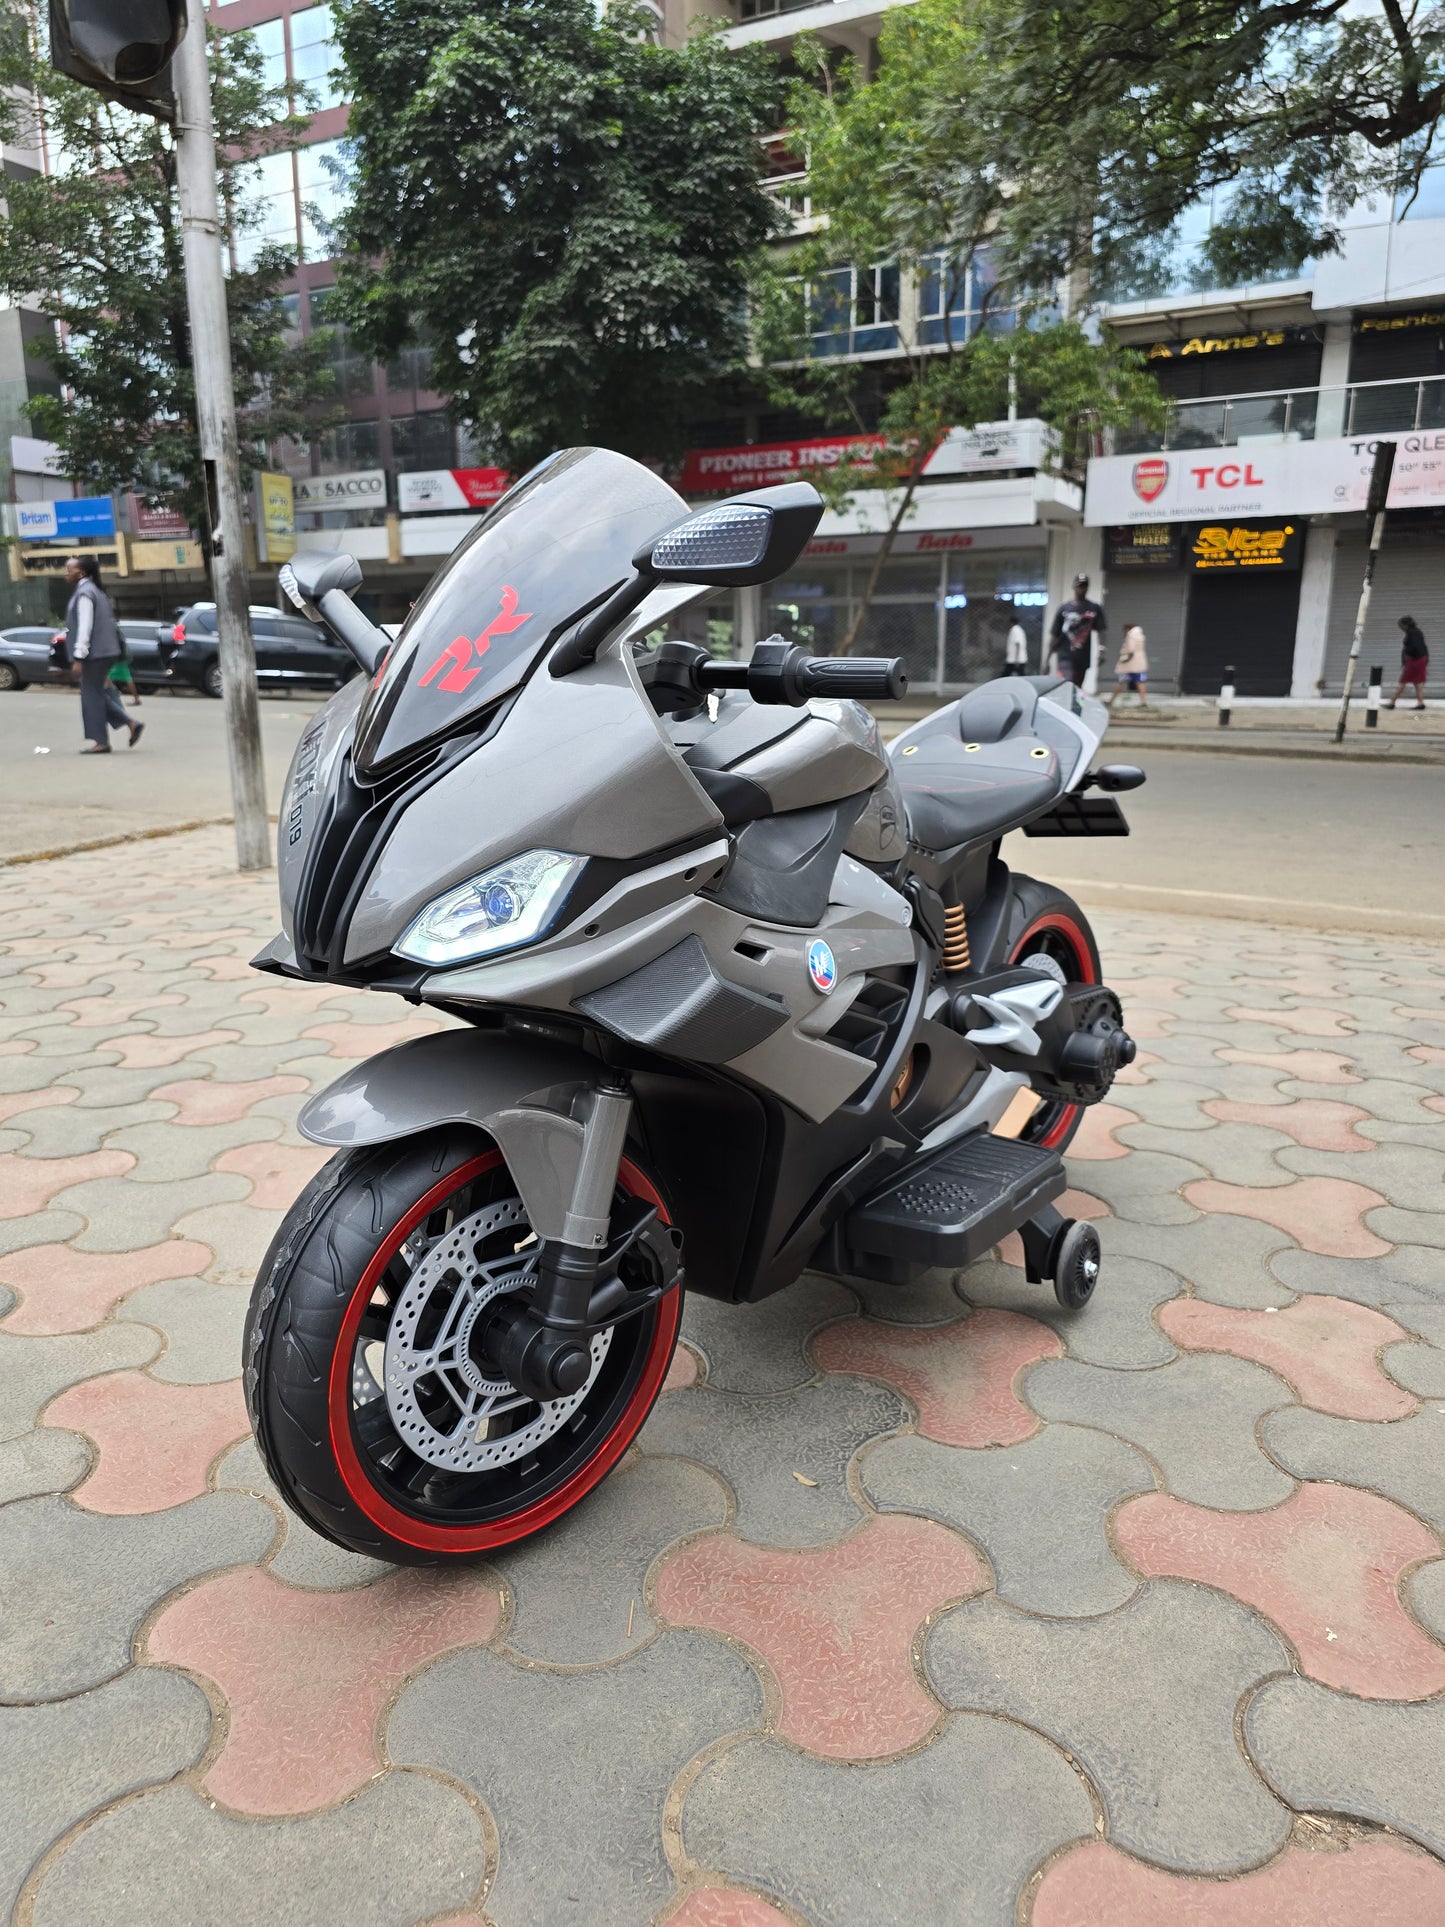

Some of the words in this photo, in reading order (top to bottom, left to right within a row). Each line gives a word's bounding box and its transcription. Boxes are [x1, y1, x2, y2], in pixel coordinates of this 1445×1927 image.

[699, 450, 793, 474] PIONEER
[1190, 463, 1264, 490] TCL
[325, 478, 383, 498] SACCO
[20, 511, 51, 526] Britam
